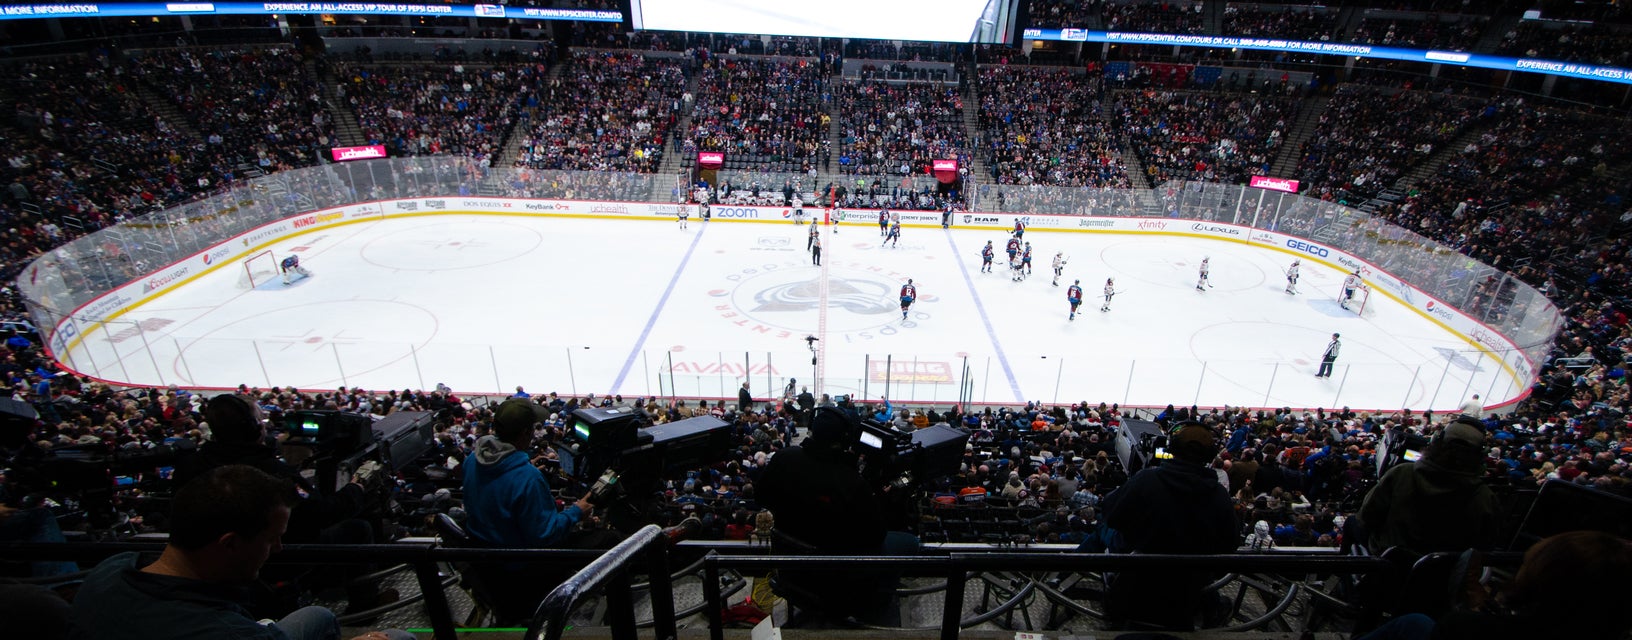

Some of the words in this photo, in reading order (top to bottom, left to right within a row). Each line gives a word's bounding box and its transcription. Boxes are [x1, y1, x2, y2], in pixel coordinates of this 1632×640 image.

[5, 6, 33, 14] MORE
[33, 5, 99, 14] INFORMATION
[264, 3, 308, 11] EXPERIENCE
[310, 3, 322, 11] AN
[323, 4, 364, 12] ALL-ACCESS
[365, 4, 376, 12] VIP
[426, 5, 452, 13] CENTER
[1106, 32, 1121, 40] VISIT
[1121, 32, 1212, 44] WWW.PEPSICENTER.COM/TOURS
[1301, 41, 1320, 49] MORE
[1321, 43, 1371, 54] INFORMATION
[1516, 60, 1562, 72] EXPERIENCE
[1562, 63, 1575, 73] AN
[1576, 64, 1623, 78] ALL-ACCESS
[526, 203, 554, 211] KeyBank
[590, 203, 629, 212] uchealth
[717, 207, 758, 218] zoom
[293, 216, 316, 228] KING
[1138, 220, 1168, 230] xfinity
[250, 226, 287, 243] DRAFTKINGS
[1204, 225, 1239, 235] LEXUS
[212, 248, 230, 261] pepsi
[1286, 239, 1329, 258] GEICO
[1434, 306, 1453, 320] pepsi
[1470, 328, 1506, 354] uchealth
[667, 361, 780, 379] AVAYA
